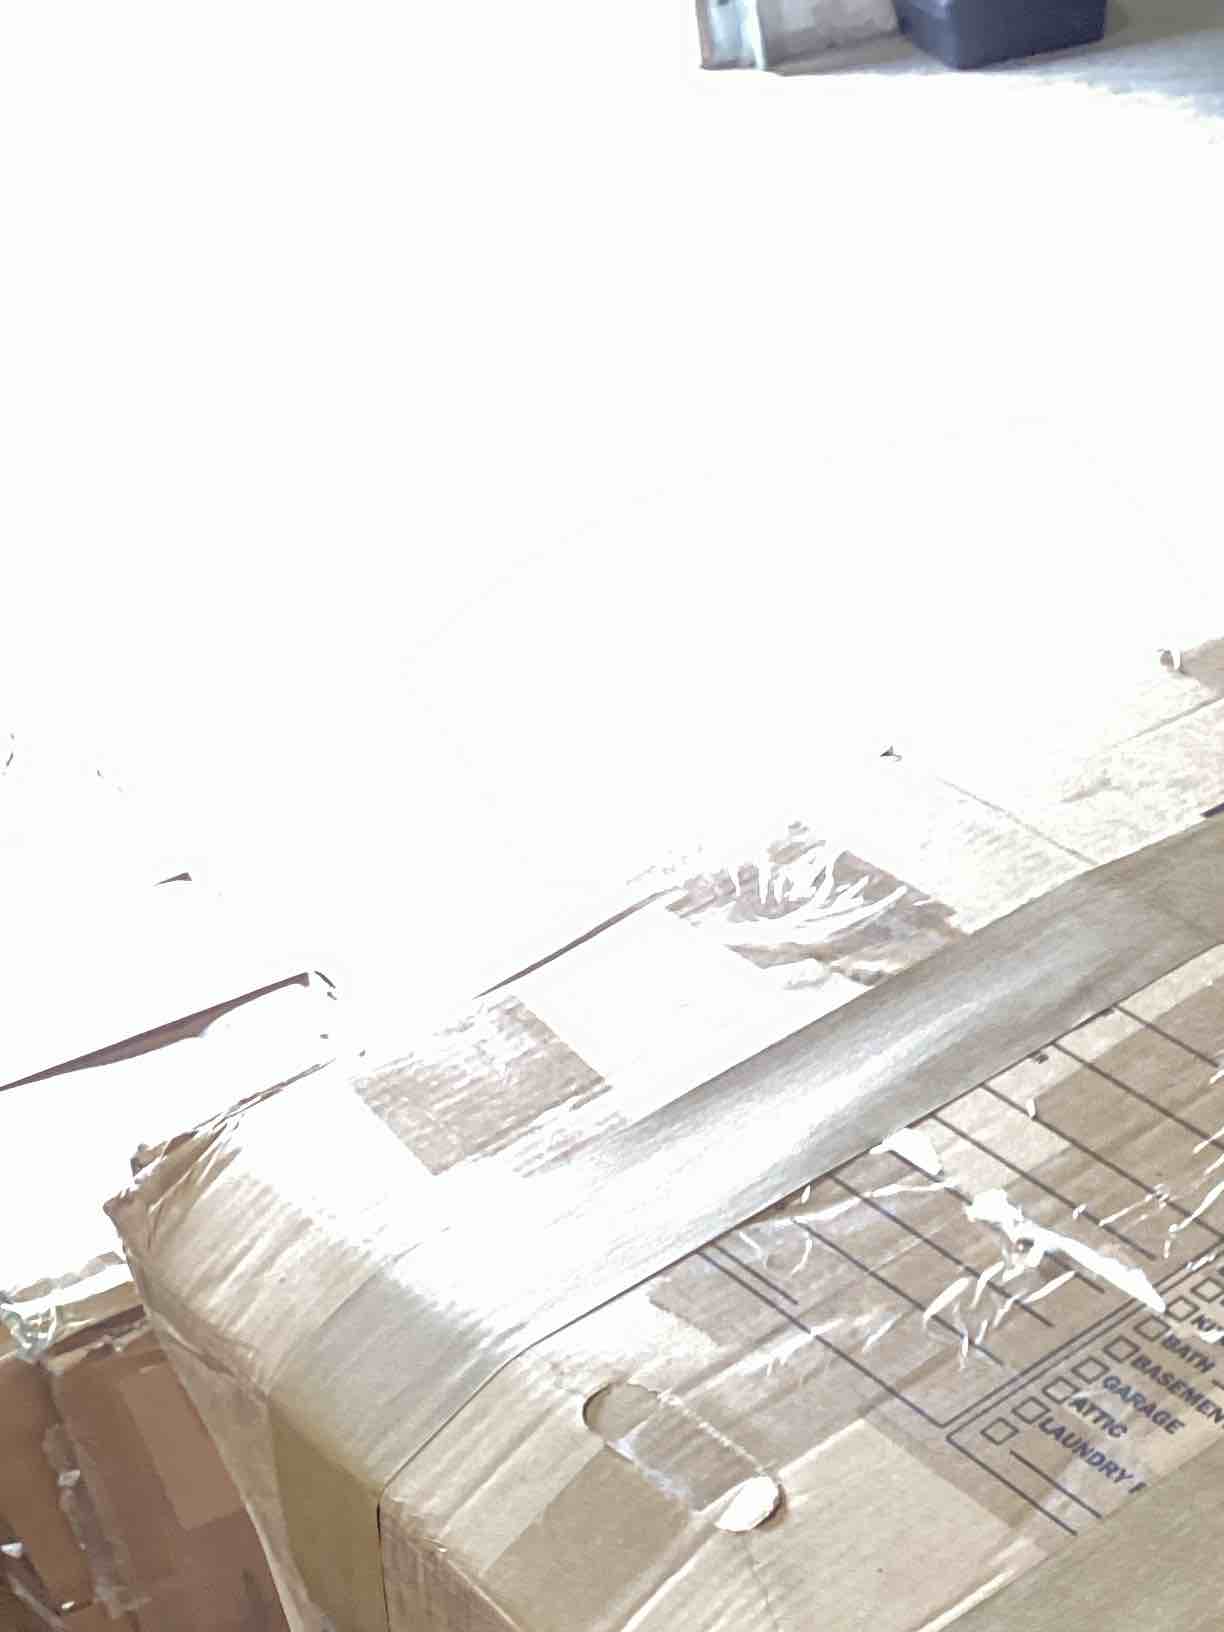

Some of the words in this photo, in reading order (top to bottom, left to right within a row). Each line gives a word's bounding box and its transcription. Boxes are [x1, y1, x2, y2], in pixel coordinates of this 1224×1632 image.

[1160, 1332, 1216, 1374] BATH
[1067, 1395, 1129, 1439] ATTIC
[1101, 1373, 1186, 1436] GARAGE
[1037, 1416, 1135, 1486] LAUNDRY
